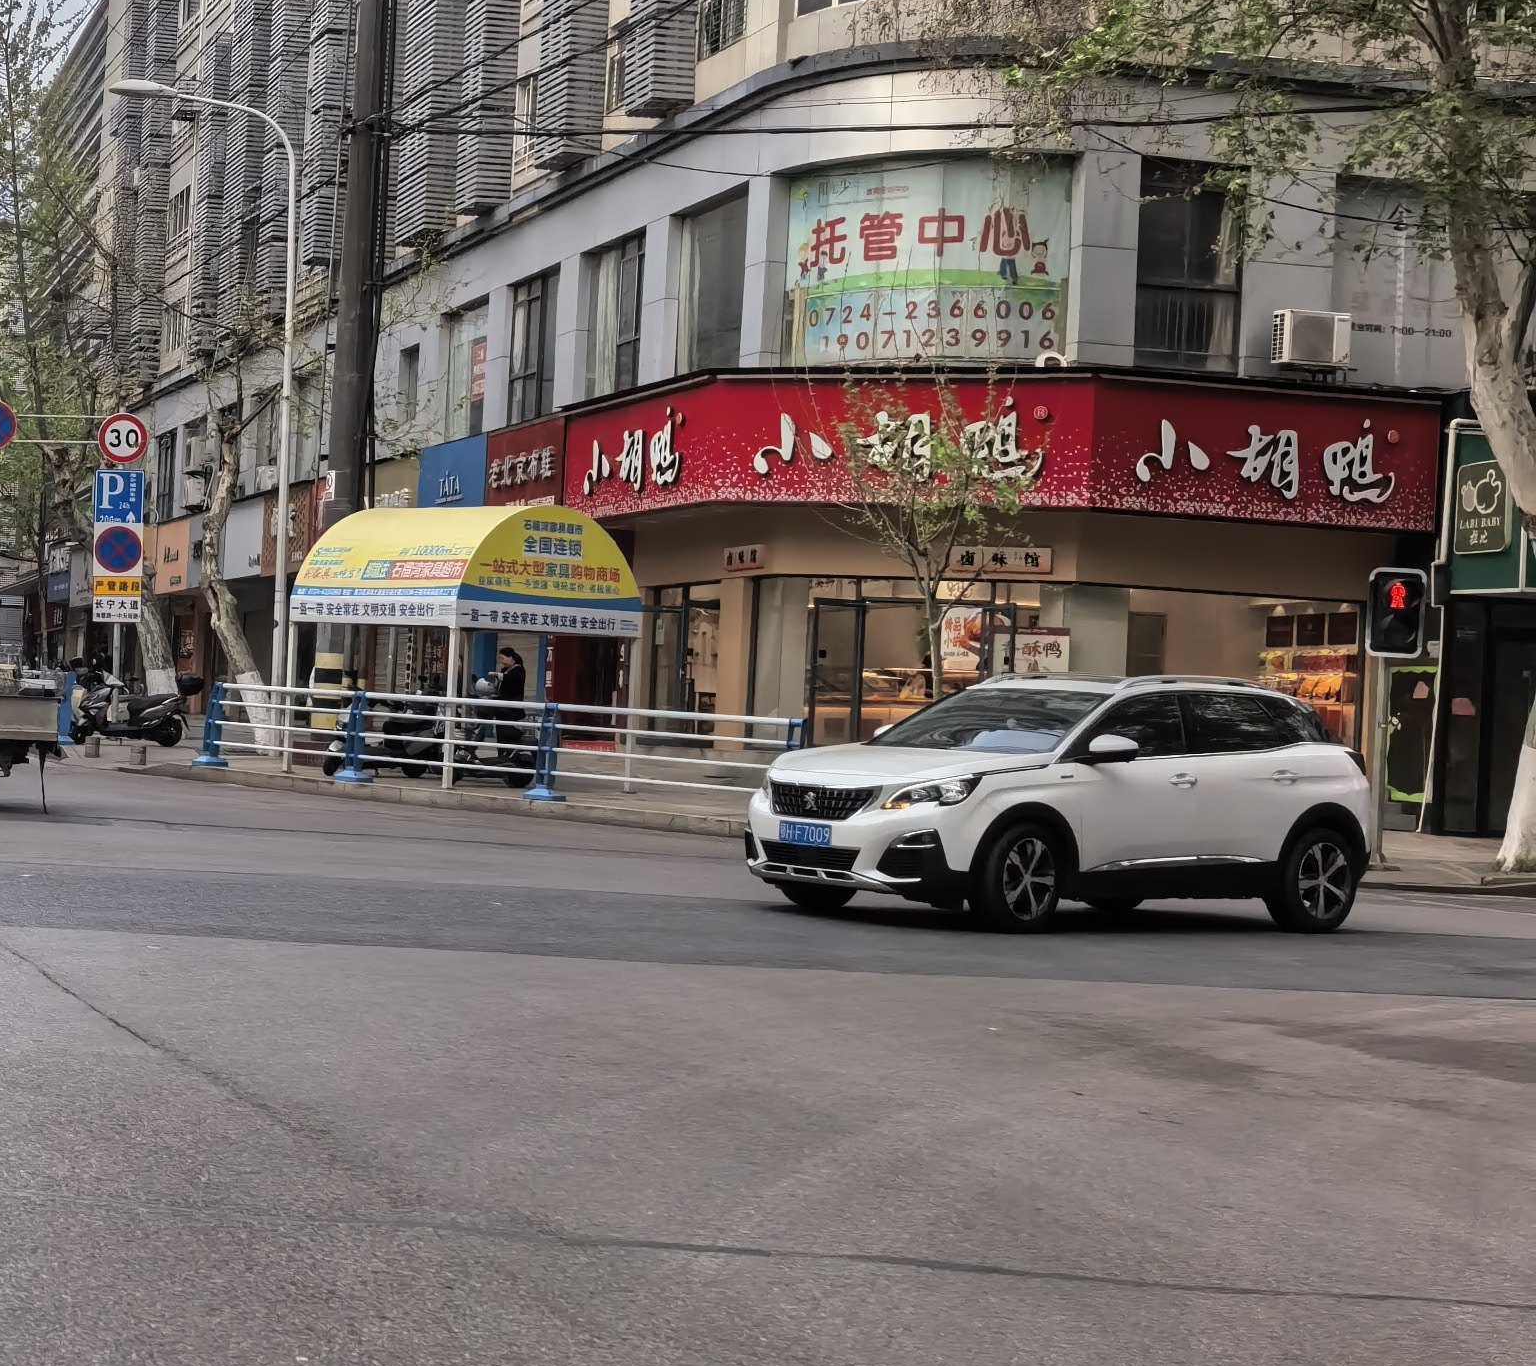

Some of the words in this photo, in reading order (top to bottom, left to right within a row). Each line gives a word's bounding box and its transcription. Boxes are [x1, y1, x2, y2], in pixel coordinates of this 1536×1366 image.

[810, 208, 1031, 268] 托管中心
[808, 299, 1056, 327] 0724-2366006
[822, 328, 1055, 351] 19071239916
[109, 428, 139, 448] 30
[753, 396, 1043, 483] 小胡鸭
[583, 406, 679, 495] 小胡鸭
[1136, 419, 1395, 504] 小胡鸭
[99, 473, 124, 509] P
[524, 536, 582, 557] 全国连锁
[479, 558, 620, 583] 一站式大型家具购物商场
[95, 580, 140, 592] 严管路段
[94, 599, 138, 610] 长宁大道
[291, 602, 324, 616] 一盔一带
[327, 603, 360, 616] 安全常在
[364, 603, 396, 617] 文明交通
[399, 603, 434, 617] 安全出行
[461, 609, 499, 623] 一盔一带
[501, 611, 538, 625] 安全常在
[541, 613, 577, 628] 文明交通
[580, 616, 615, 631] 安全出行
